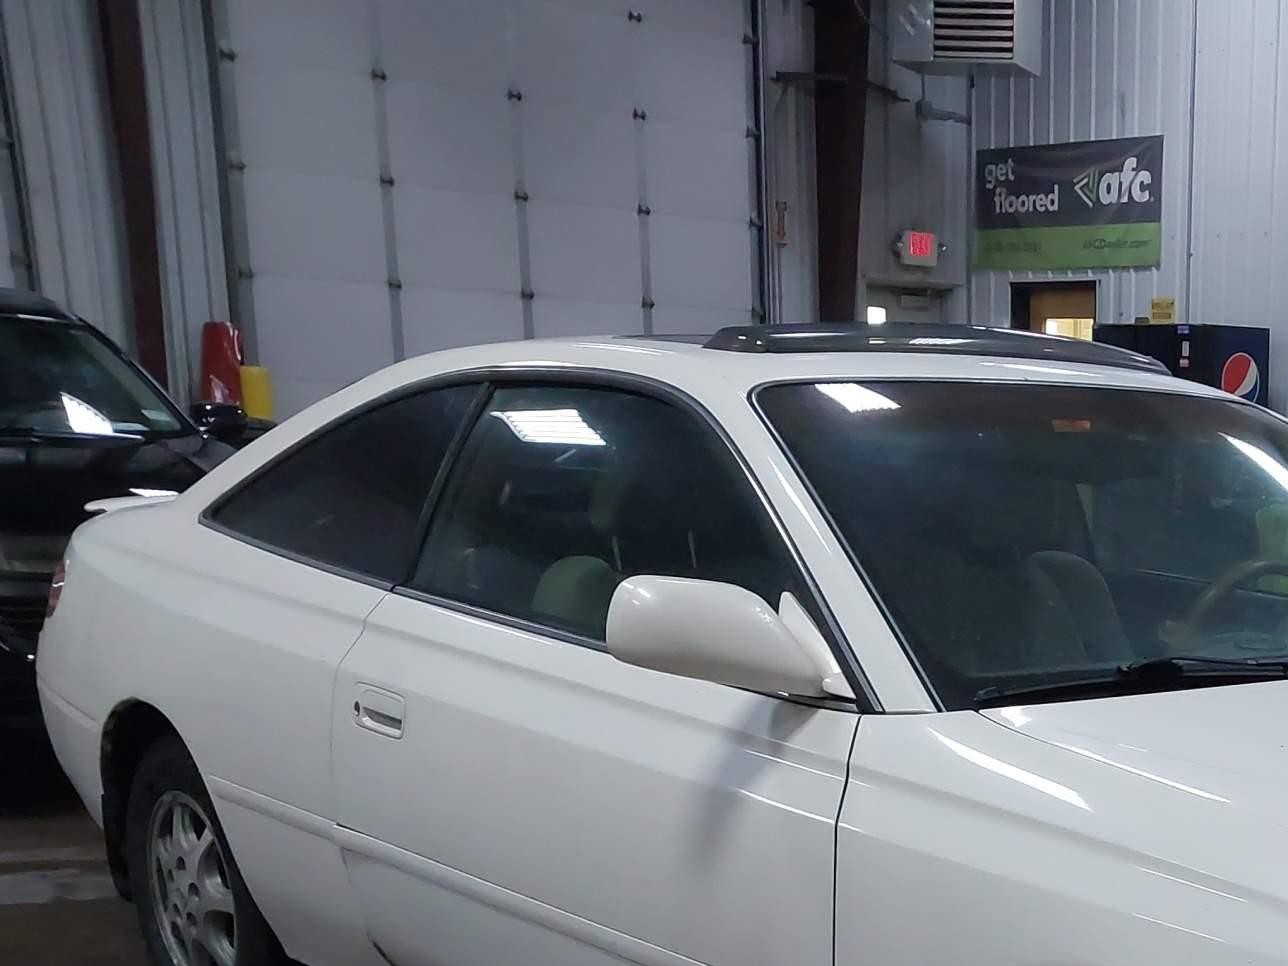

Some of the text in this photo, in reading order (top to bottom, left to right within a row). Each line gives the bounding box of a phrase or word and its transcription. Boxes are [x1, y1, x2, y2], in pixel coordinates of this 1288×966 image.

[985, 158, 1015, 189] get
[1099, 157, 1152, 205] afc
[993, 184, 1059, 214] floored
